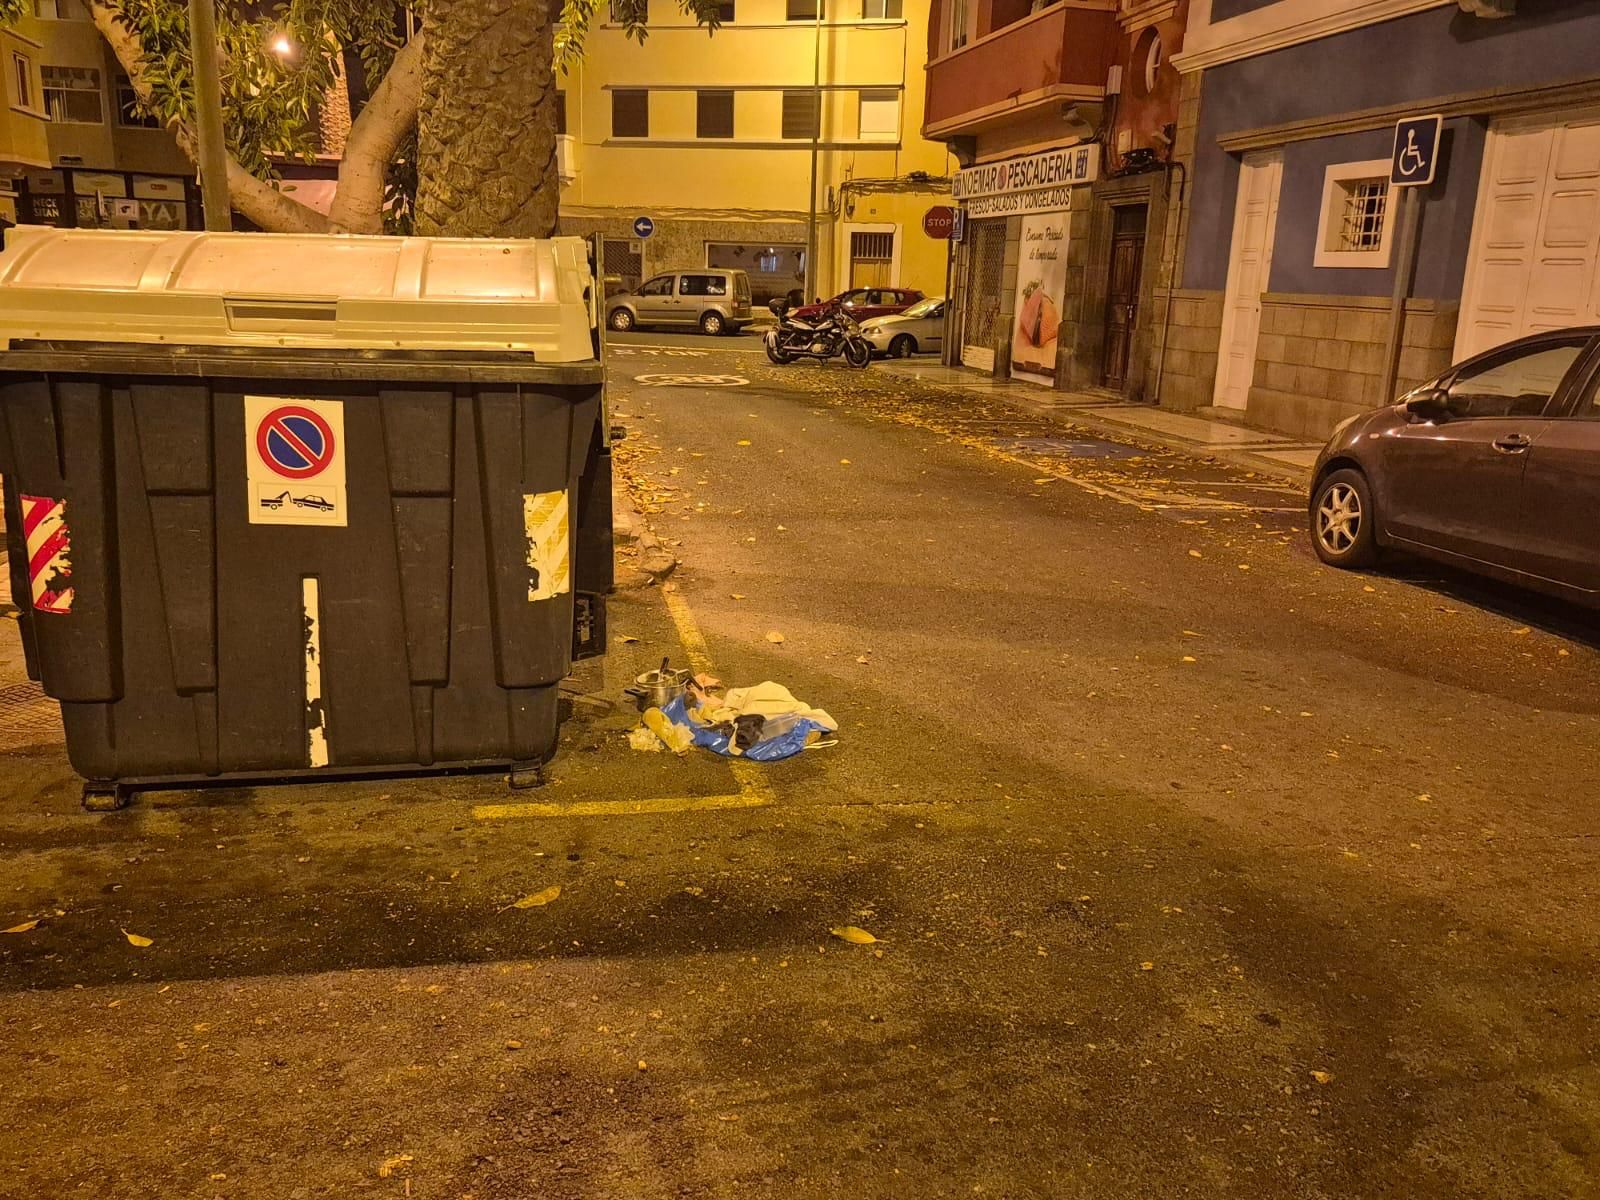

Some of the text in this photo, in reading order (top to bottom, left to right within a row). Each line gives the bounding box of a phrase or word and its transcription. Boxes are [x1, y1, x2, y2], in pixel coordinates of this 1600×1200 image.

[962, 152, 1072, 196] NOEMAR PESCADERIA
[1024, 188, 1070, 209] CONGELADOS
[927, 218, 952, 227] STOP
